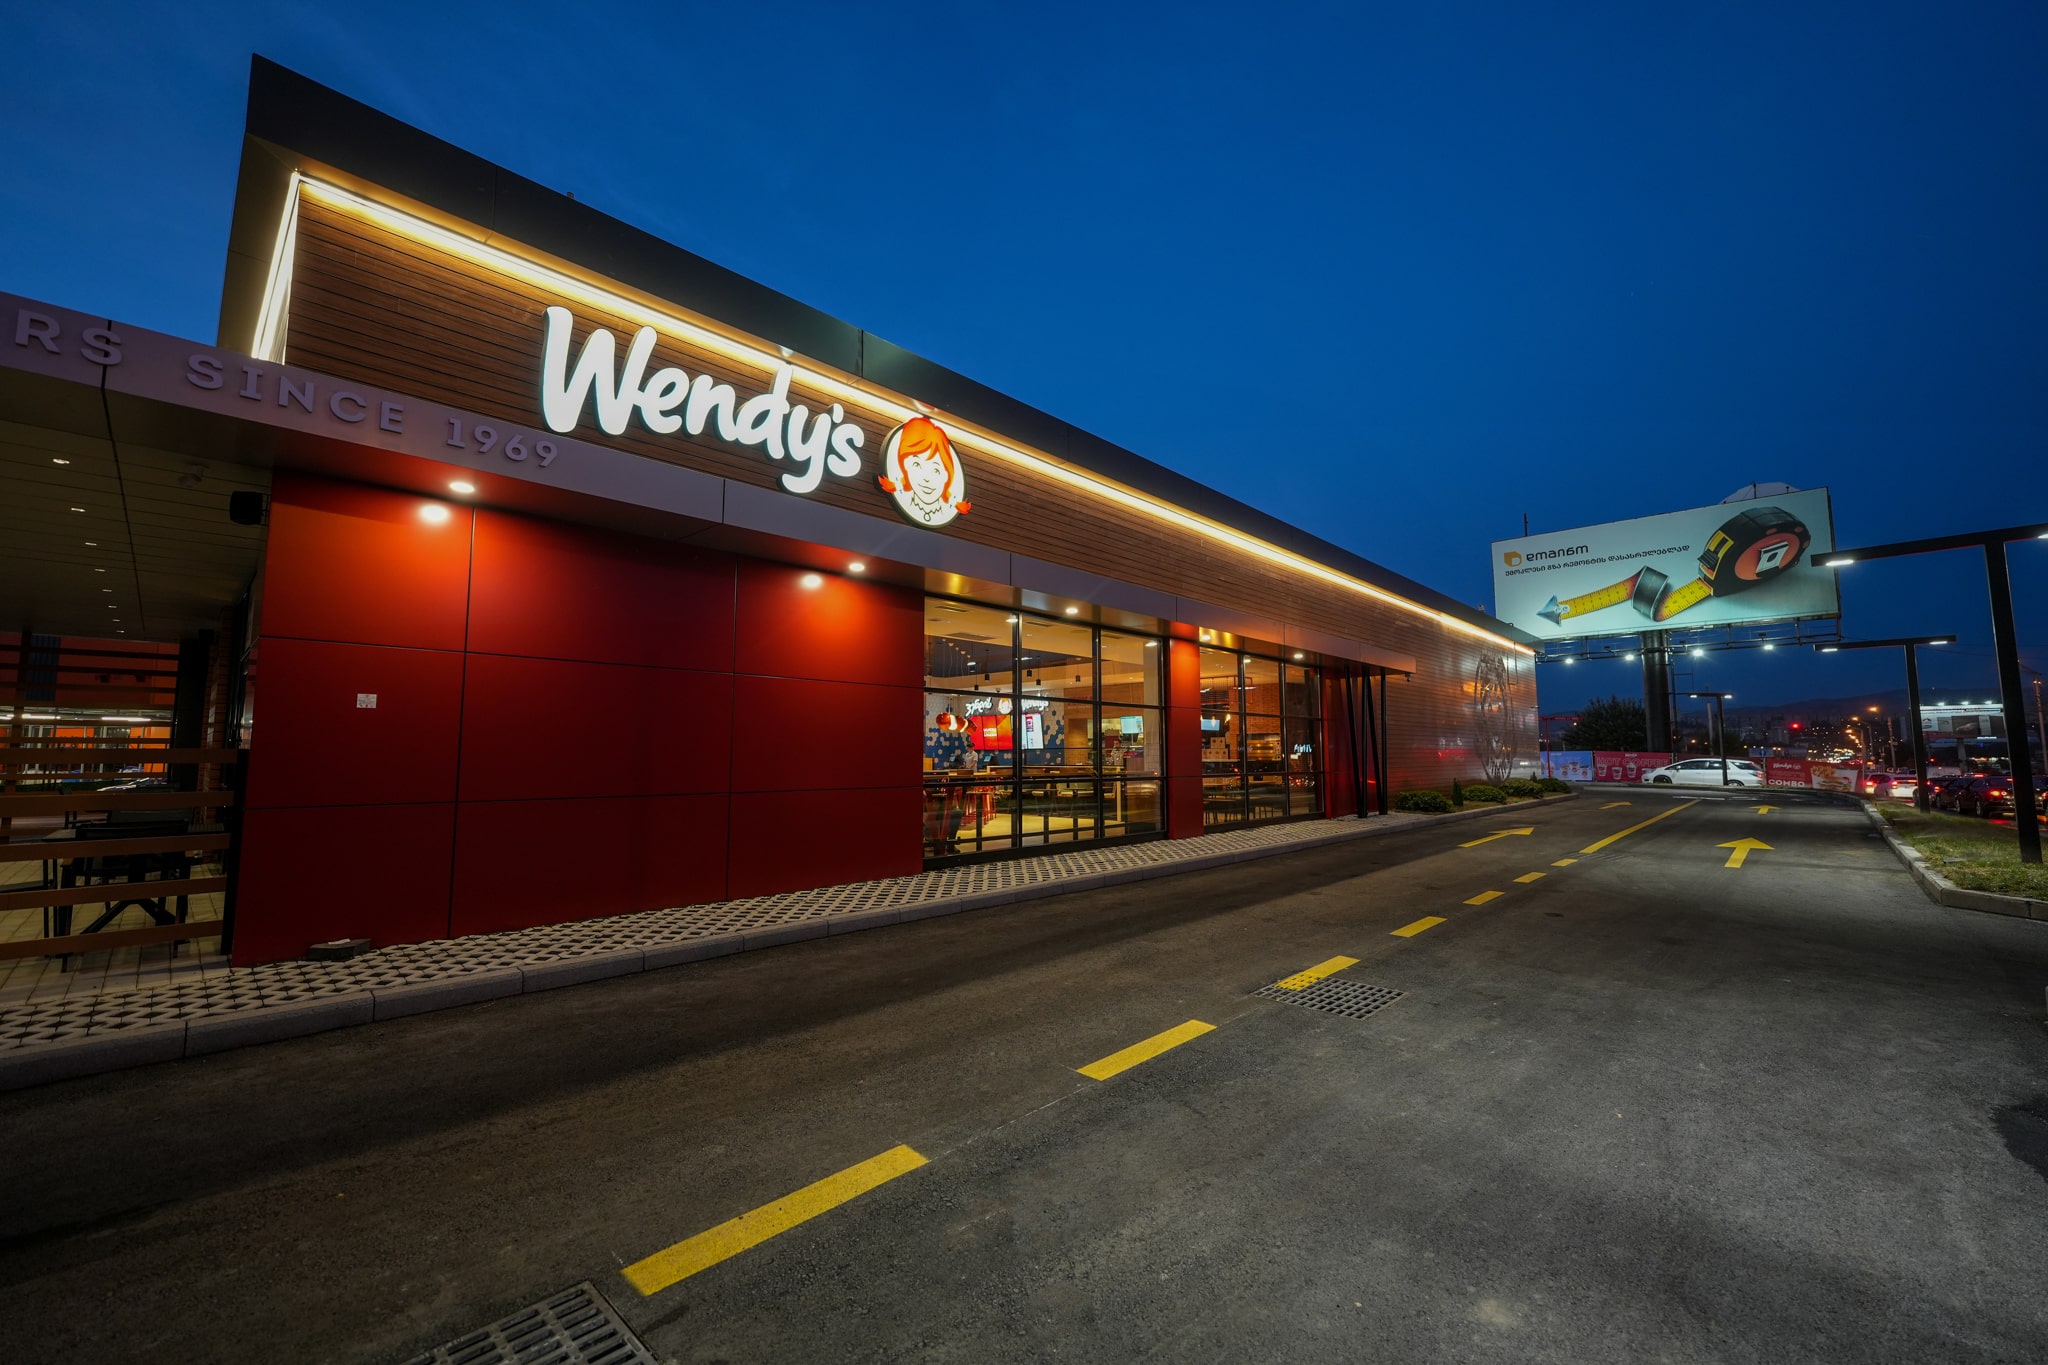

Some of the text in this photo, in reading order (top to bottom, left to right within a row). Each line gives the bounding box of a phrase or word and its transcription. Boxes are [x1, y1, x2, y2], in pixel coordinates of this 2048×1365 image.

[186, 353, 405, 435] SINCE
[446, 416, 559, 469] 1969
[541, 305, 865, 494] Wendy's
[1768, 779, 1806, 788] COMBO
